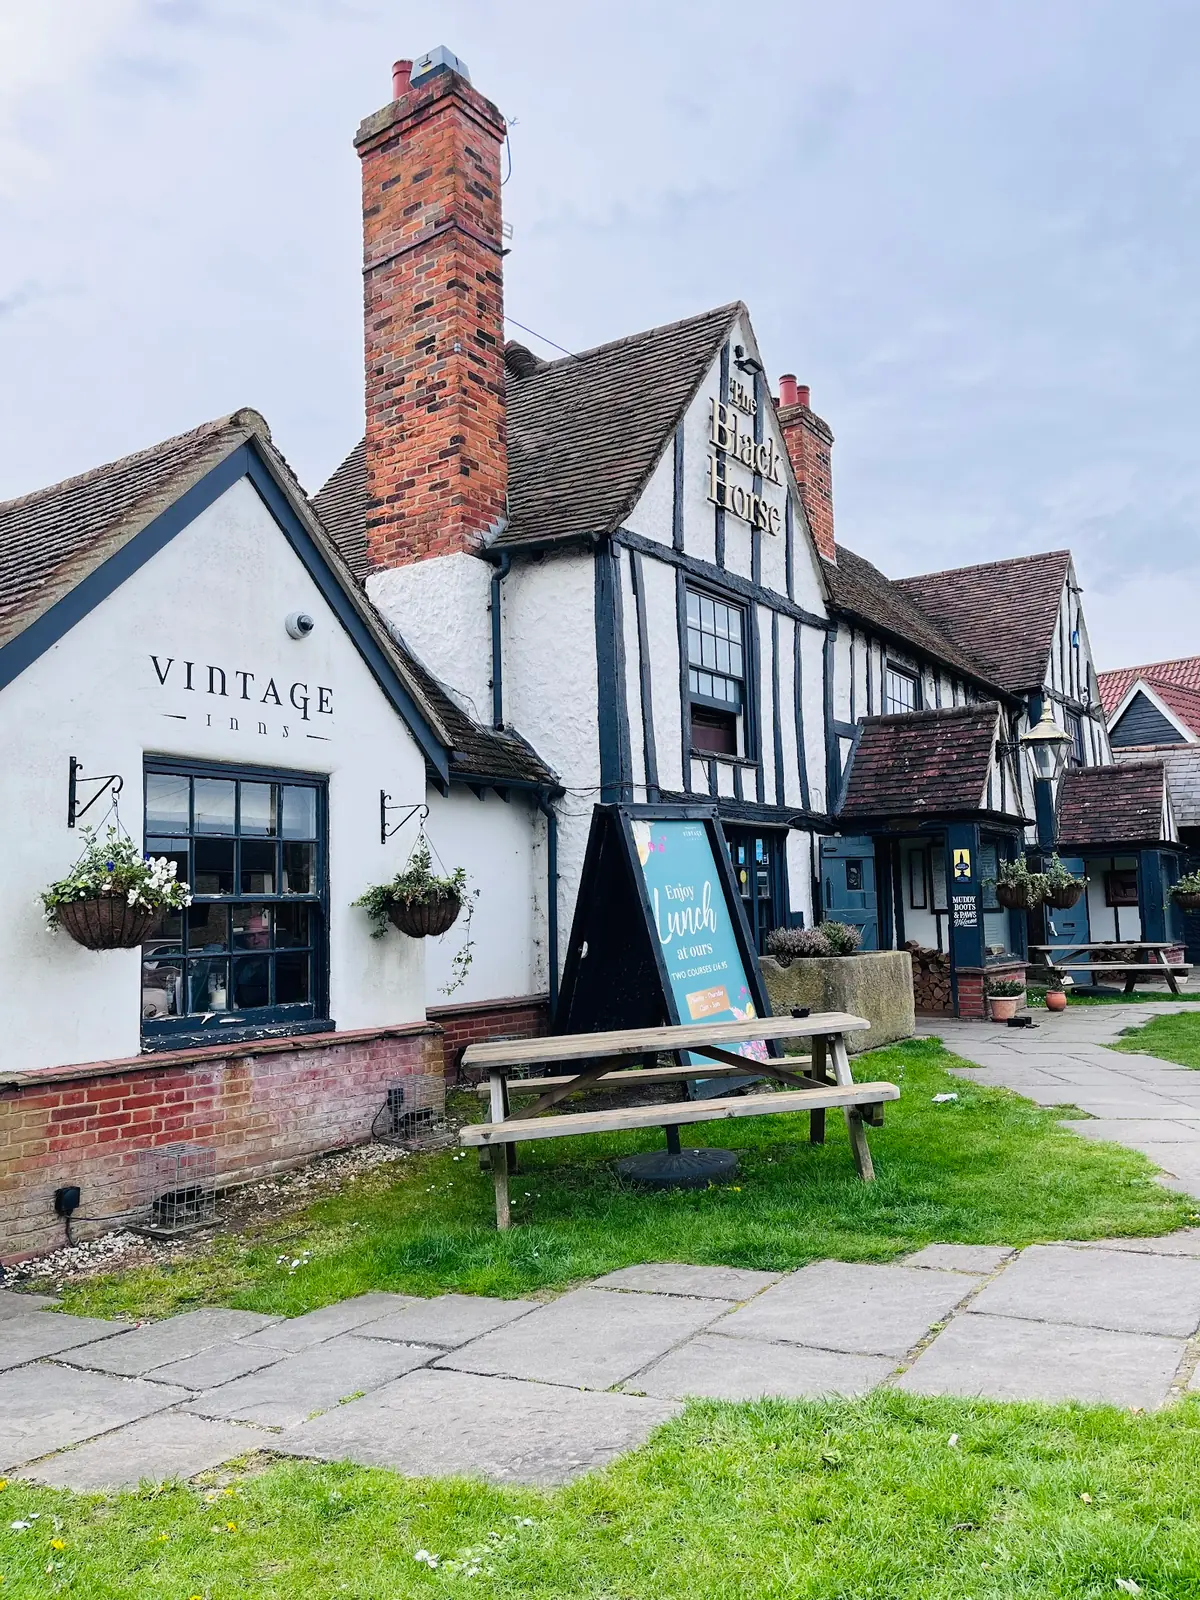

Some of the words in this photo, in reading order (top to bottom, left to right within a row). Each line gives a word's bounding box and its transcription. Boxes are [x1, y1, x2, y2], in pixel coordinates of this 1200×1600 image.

[729, 377, 757, 417] The
[709, 396, 784, 487] Black
[707, 454, 781, 536] Horse
[149, 654, 334, 721] VINTAGE
[665, 883, 694, 902] Enjoy
[952, 896, 976, 904] MUDDY
[654, 881, 717, 944] Lunch
[953, 911, 960, 919] &
[960, 911, 977, 919] PAWS
[954, 903, 976, 911] BOOTS
[677, 945, 688, 960] at
[690, 943, 713, 958] ours
[671, 971, 687, 980] TWO
[687, 964, 712, 977] COURSES
